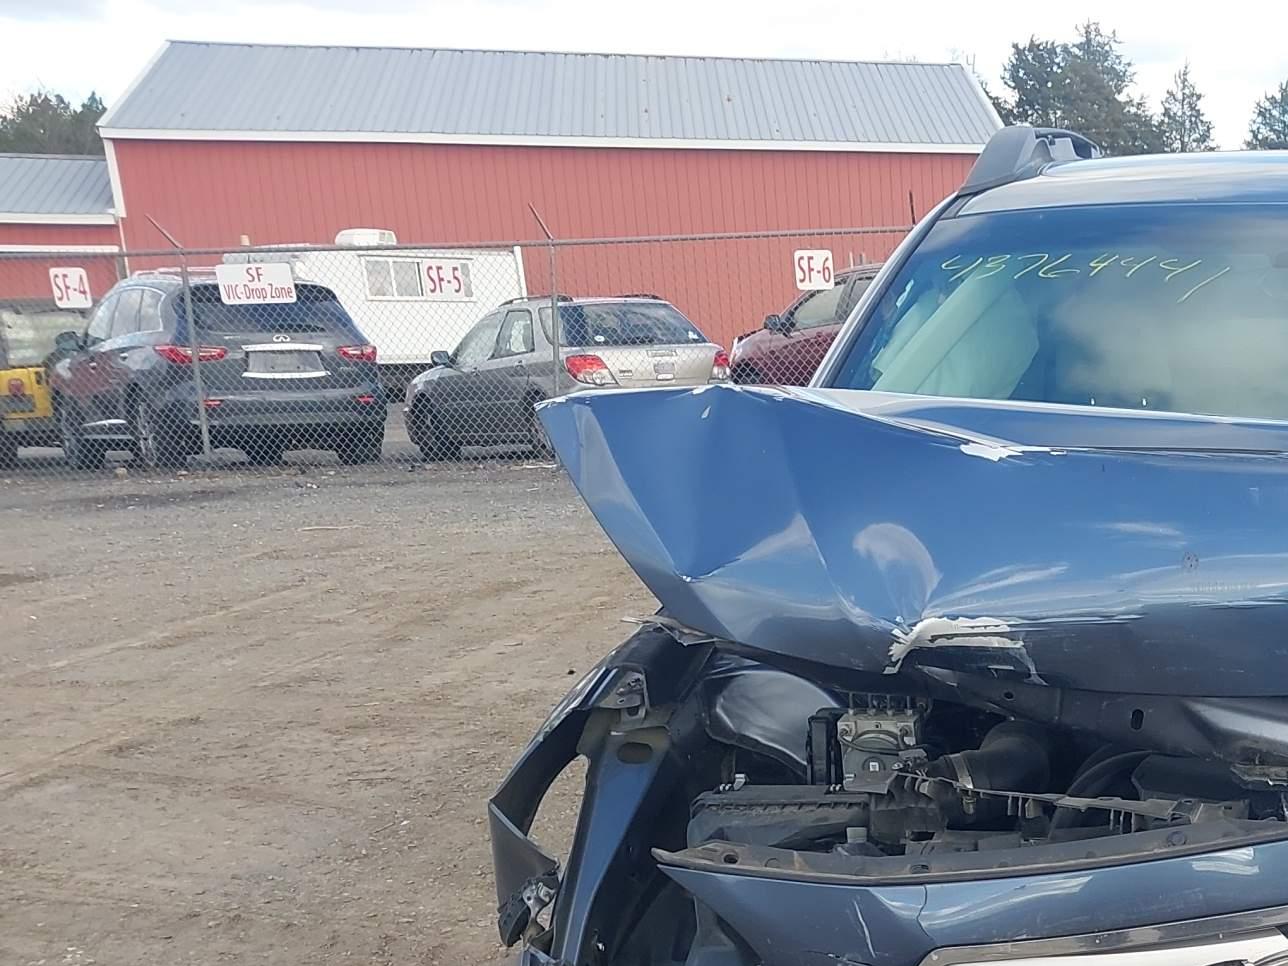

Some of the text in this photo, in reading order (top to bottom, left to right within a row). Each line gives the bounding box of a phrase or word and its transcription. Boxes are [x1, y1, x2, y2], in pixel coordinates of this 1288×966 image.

[246, 266, 264, 283] SF
[426, 265, 462, 294] SF-5
[797, 255, 831, 284] SF-6
[53, 273, 88, 302] SF-4
[223, 283, 294, 301] VIC-Drop Zone
